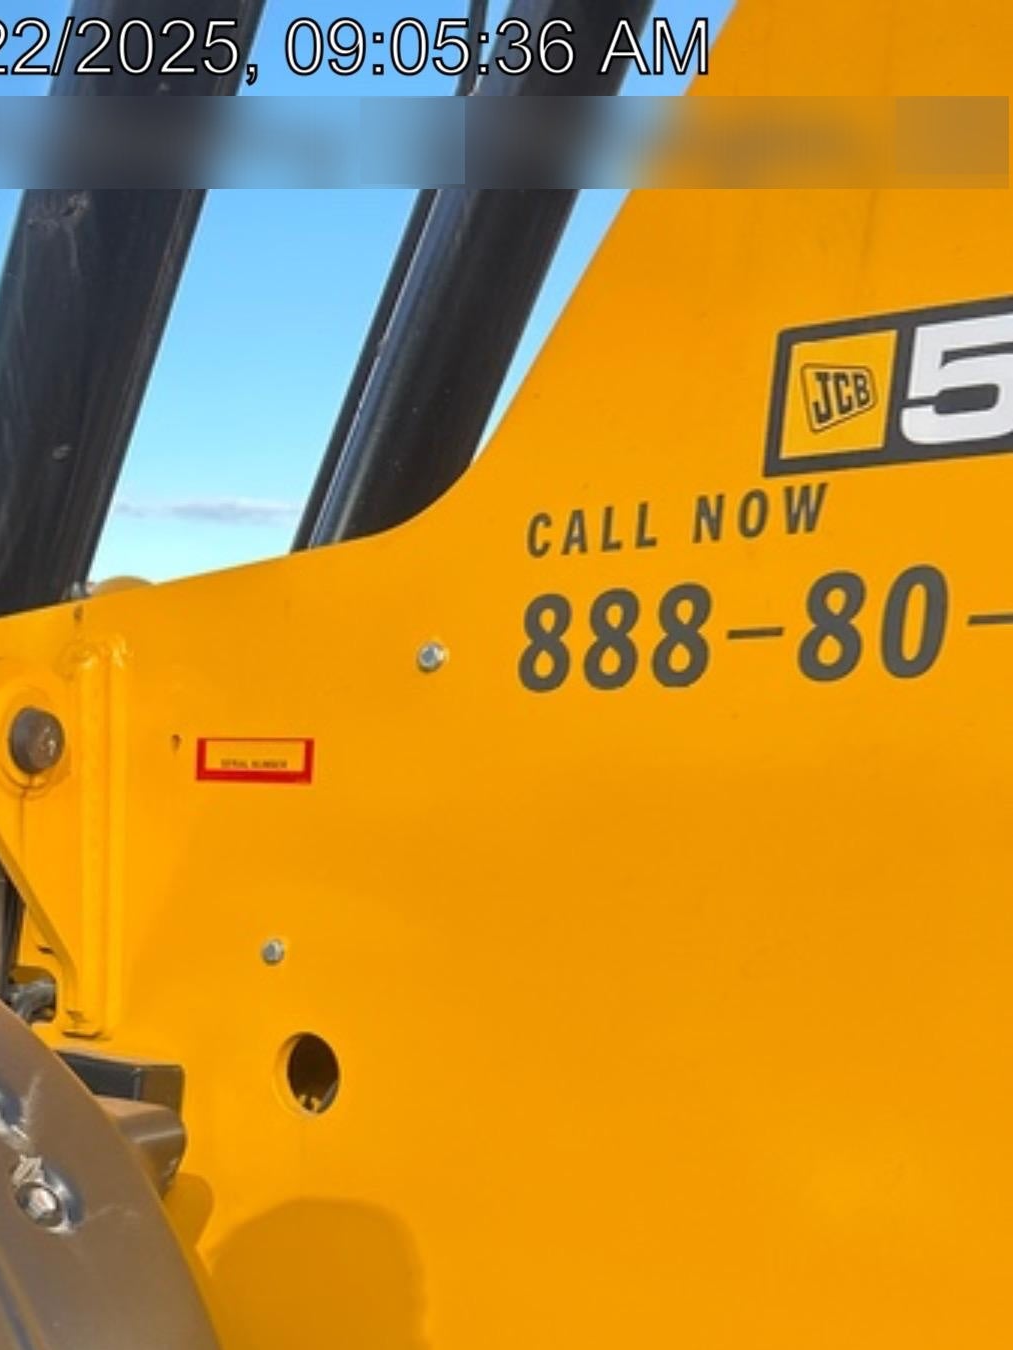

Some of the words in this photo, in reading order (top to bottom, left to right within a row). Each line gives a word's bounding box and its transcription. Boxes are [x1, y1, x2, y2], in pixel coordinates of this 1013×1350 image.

[812, 371, 870, 424] JCB
[899, 313, 1013, 446] 5
[526, 502, 658, 558] CALL
[692, 482, 828, 544] NOW
